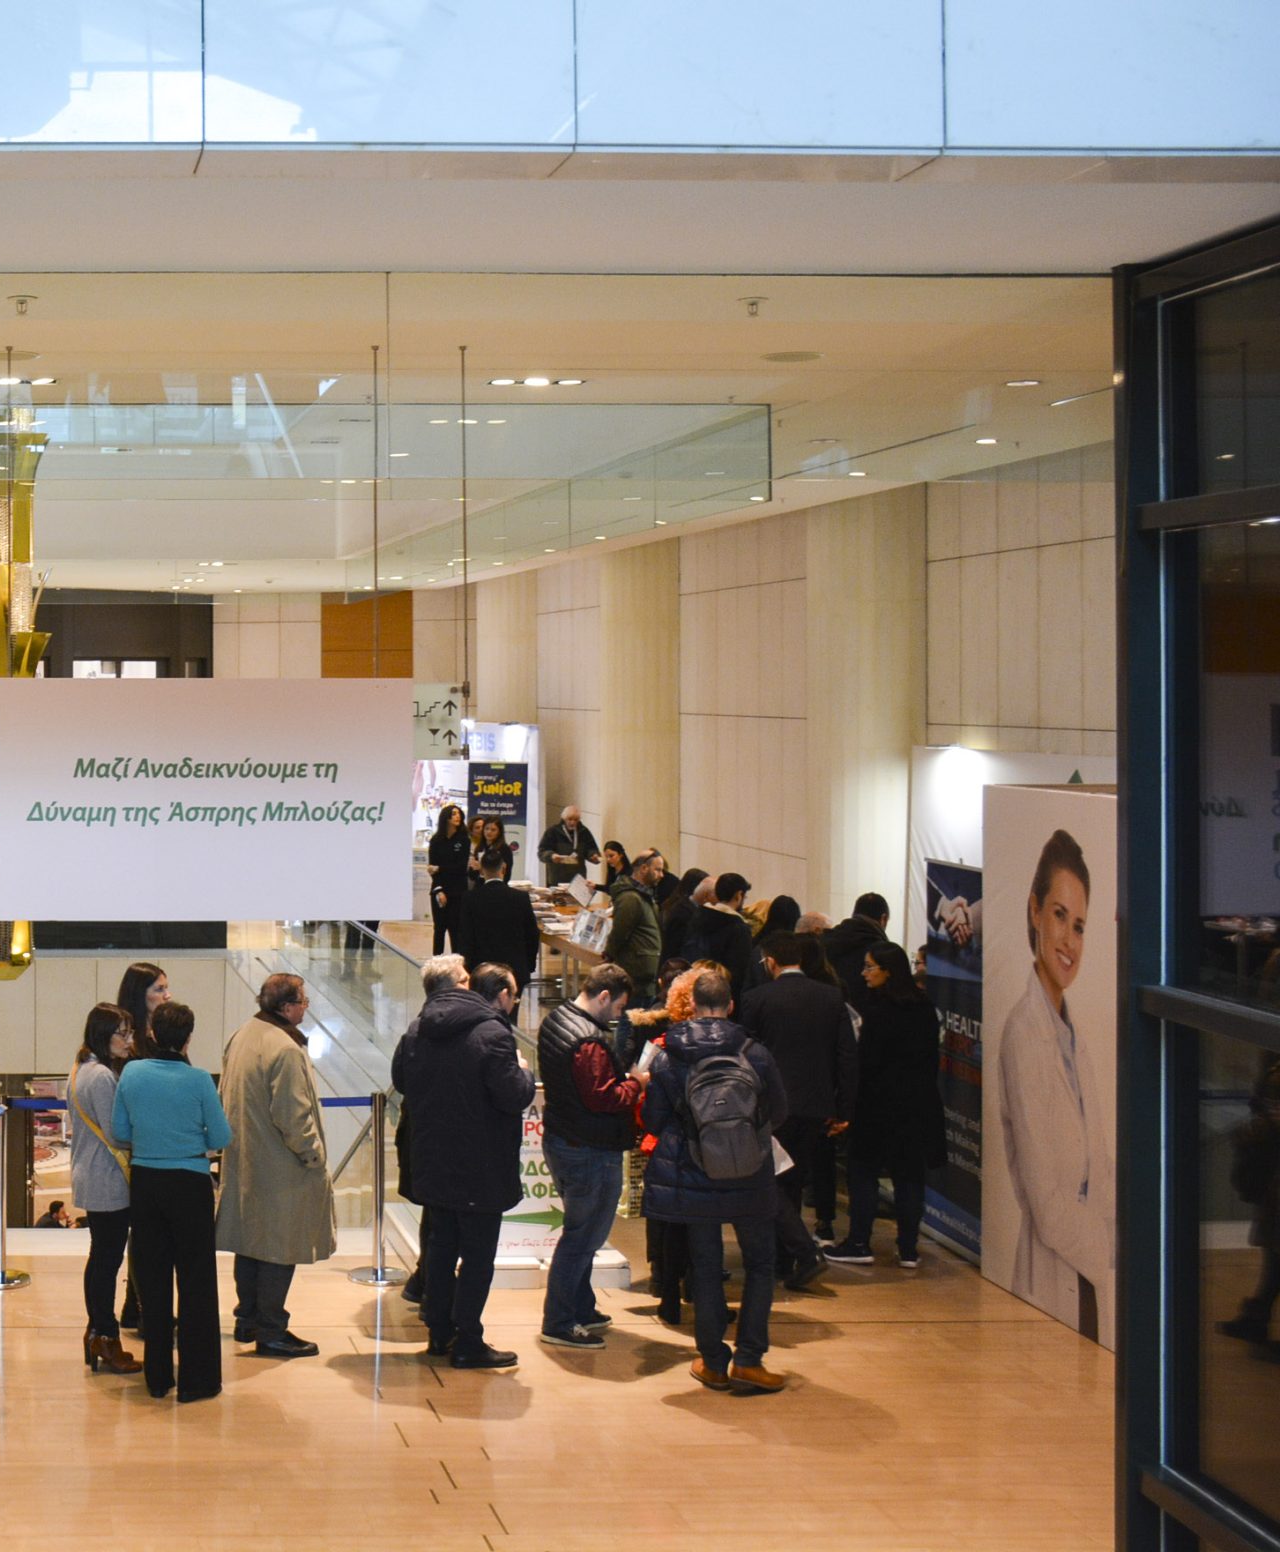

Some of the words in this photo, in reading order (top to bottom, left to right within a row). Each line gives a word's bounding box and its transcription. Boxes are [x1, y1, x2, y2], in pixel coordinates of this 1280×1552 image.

[73, 757, 132, 783] Μαζί
[133, 757, 308, 783] Αναδεικνύουμε
[313, 763, 338, 783] τη
[26, 801, 117, 827] Δύναμη
[122, 806, 160, 827] της
[168, 801, 257, 827] Άσπρης
[261, 801, 385, 827] Μπλούζας!
[946, 1010, 982, 1041] HEALT
